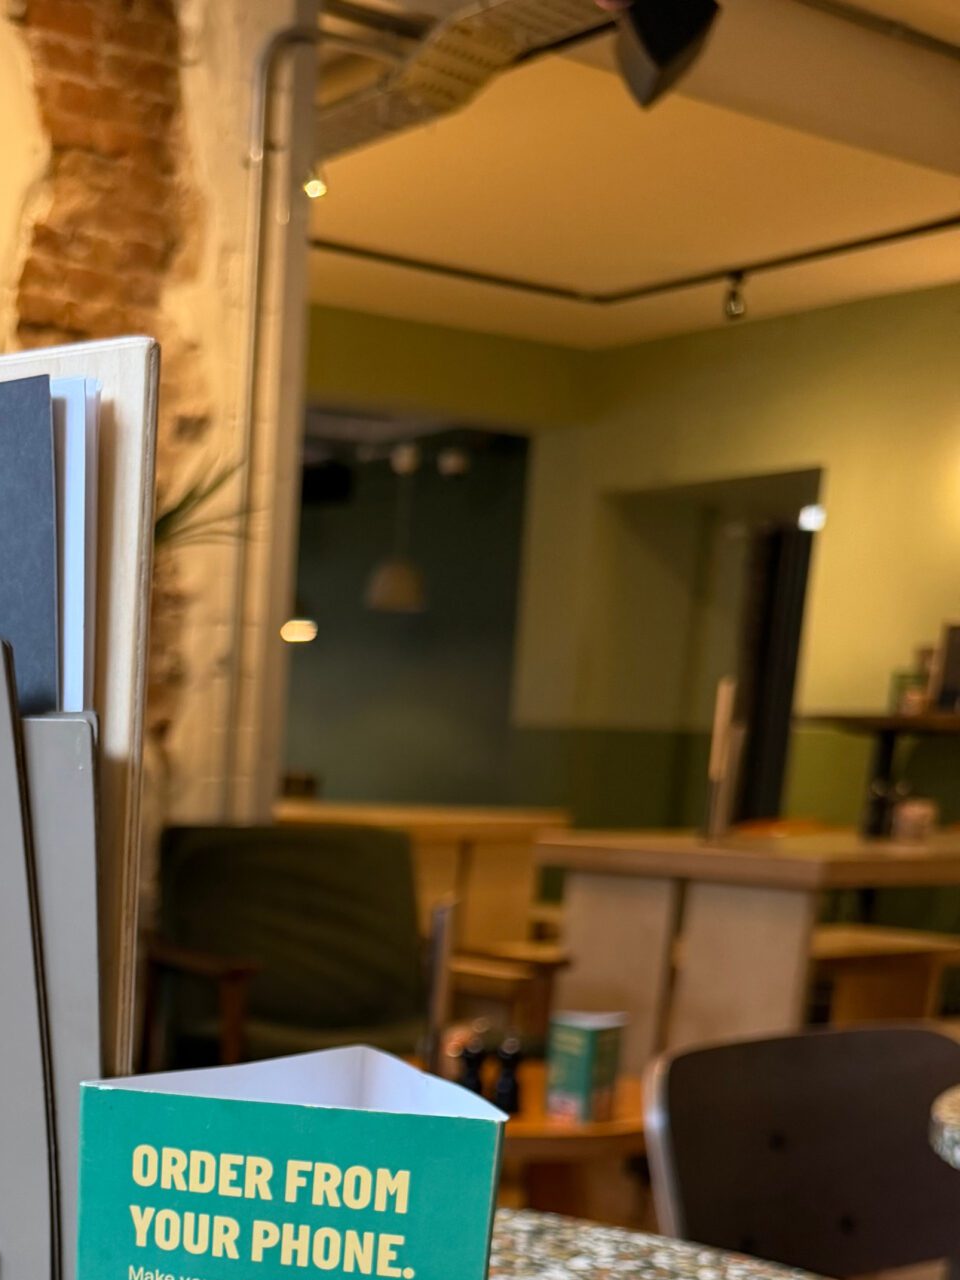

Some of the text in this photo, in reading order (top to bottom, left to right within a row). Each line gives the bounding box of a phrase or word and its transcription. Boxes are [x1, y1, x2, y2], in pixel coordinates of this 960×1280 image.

[132, 1144, 410, 1214] ORDER FROM
[129, 1205, 416, 1279] YOUR PHONE.
